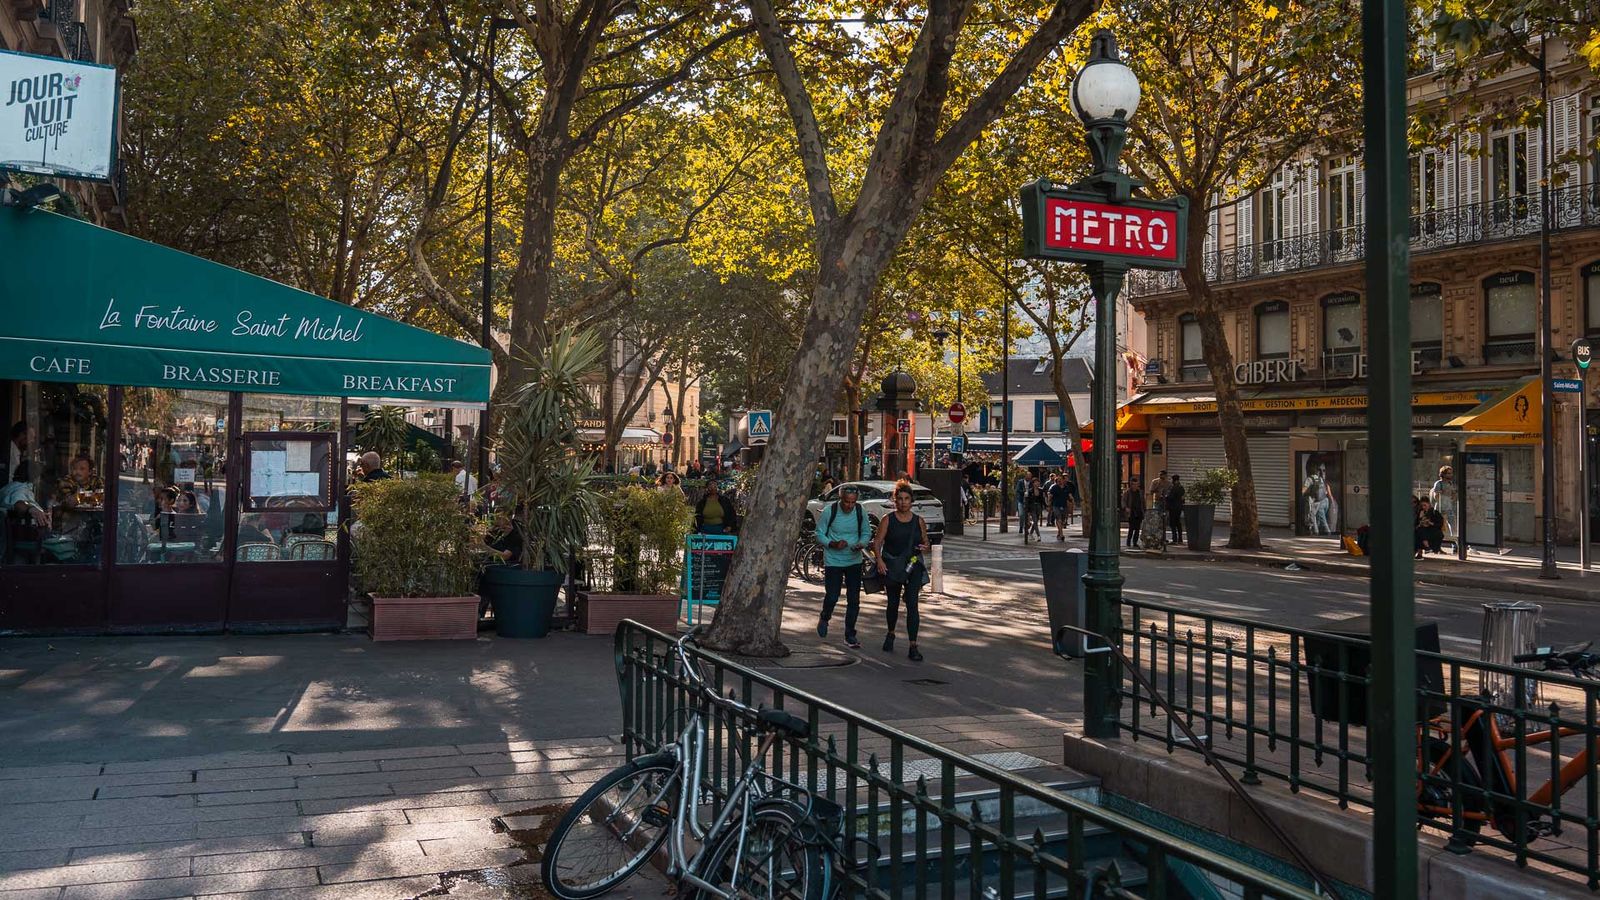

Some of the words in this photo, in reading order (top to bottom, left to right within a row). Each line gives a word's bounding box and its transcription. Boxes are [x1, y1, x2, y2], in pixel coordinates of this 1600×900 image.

[6, 72, 63, 106] JOUR
[24, 95, 78, 129] NUIT
[25, 120, 69, 143] CULTURE
[1055, 206, 1168, 251] METRO
[100, 298, 122, 330] La
[135, 305, 219, 333] Fontaine
[231, 310, 291, 337] Saint
[294, 315, 364, 342] Michel
[1234, 360, 1300, 384] GIBERT
[1350, 351, 1424, 380] JEE
[1577, 345, 1591, 356] BUS
[29, 355, 92, 376] CAFE
[161, 364, 282, 387] BRASSERIE
[342, 374, 458, 394] BREAKFAST
[1193, 403, 1212, 411] DROIT
[1265, 399, 1296, 408] GESTION
[1306, 399, 1319, 407] BTS
[1330, 397, 1368, 406] MEDECINE
